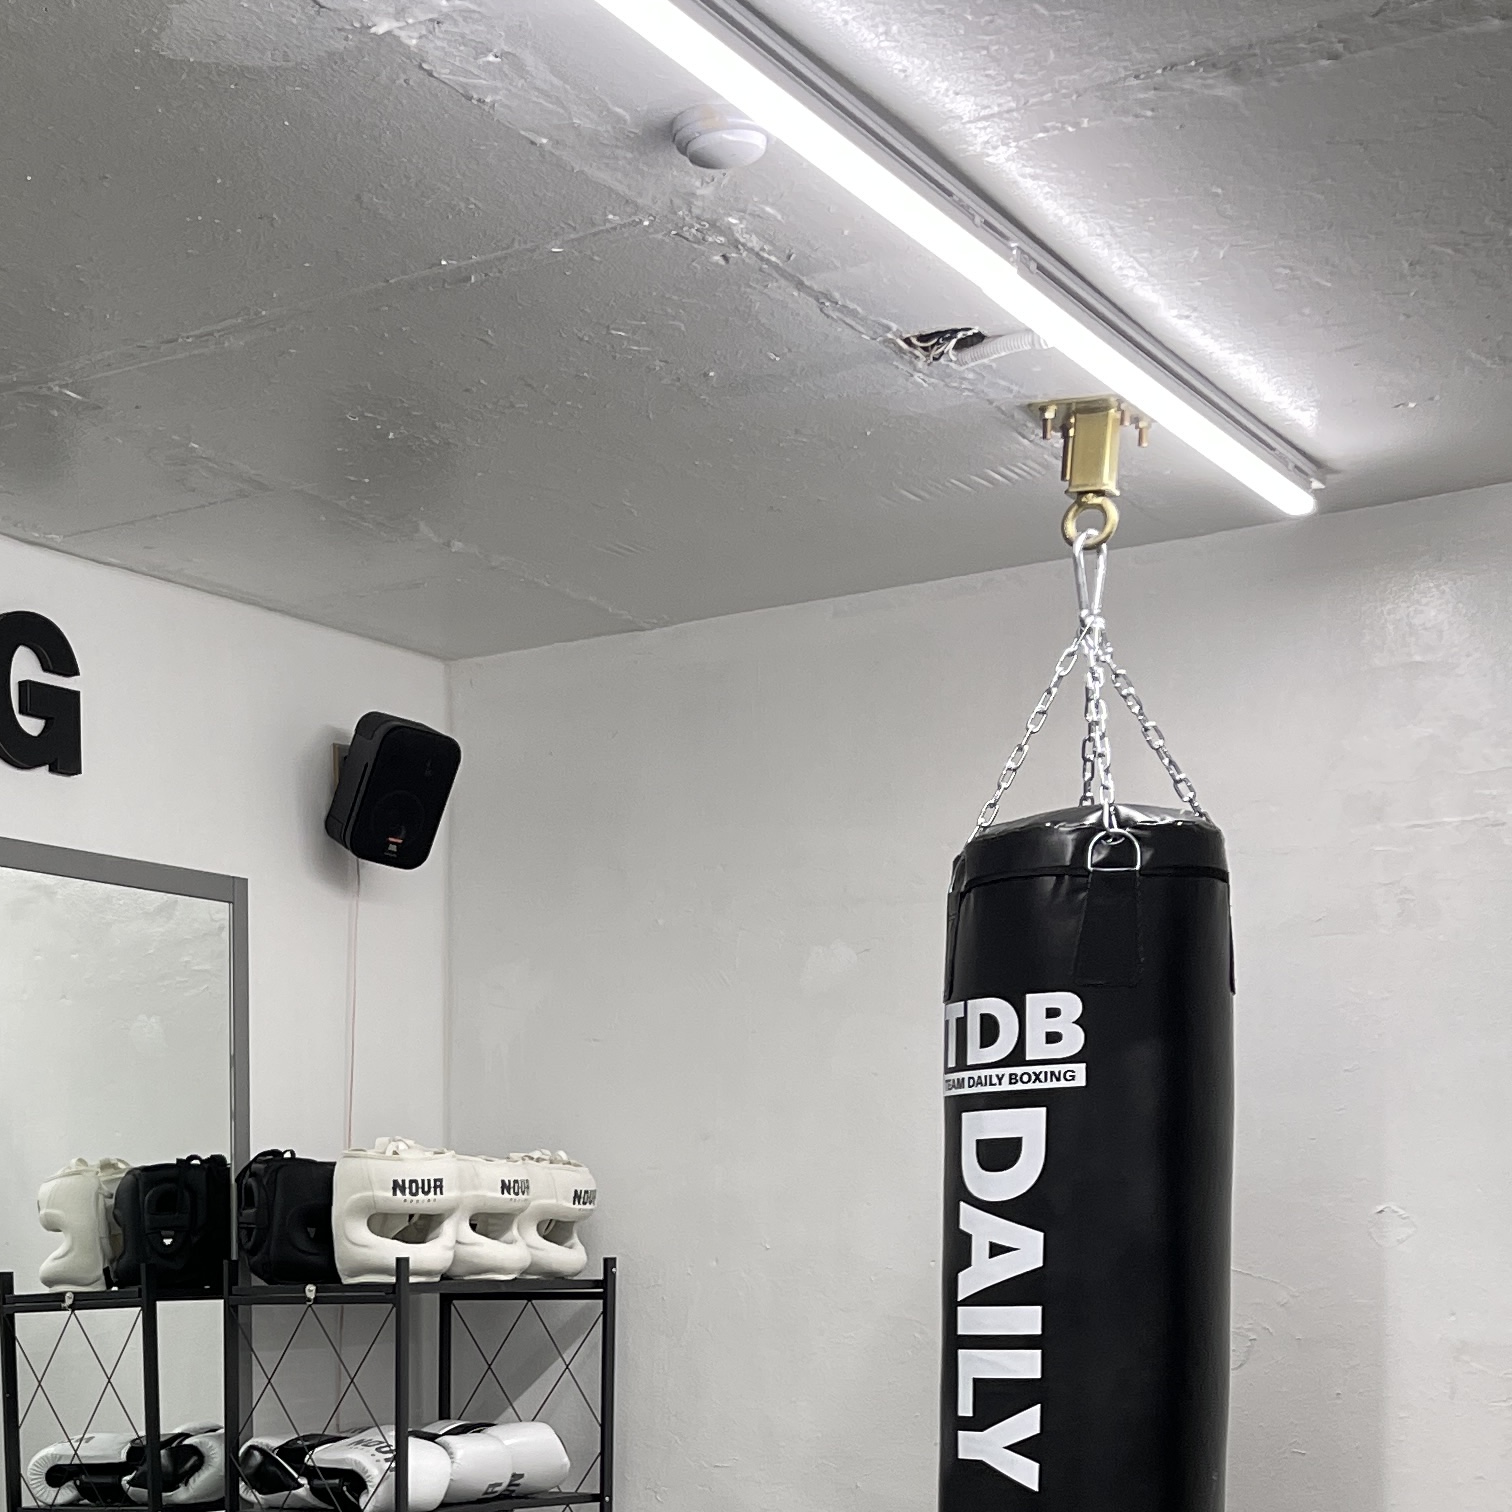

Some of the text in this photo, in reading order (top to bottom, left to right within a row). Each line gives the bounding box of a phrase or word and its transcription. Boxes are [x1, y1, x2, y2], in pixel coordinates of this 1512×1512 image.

[944, 991, 1086, 1069] TDB
[967, 1073, 1006, 1089] DAILY
[1008, 1069, 1076, 1086] BOXING
[958, 1107, 1046, 1492] DAILY
